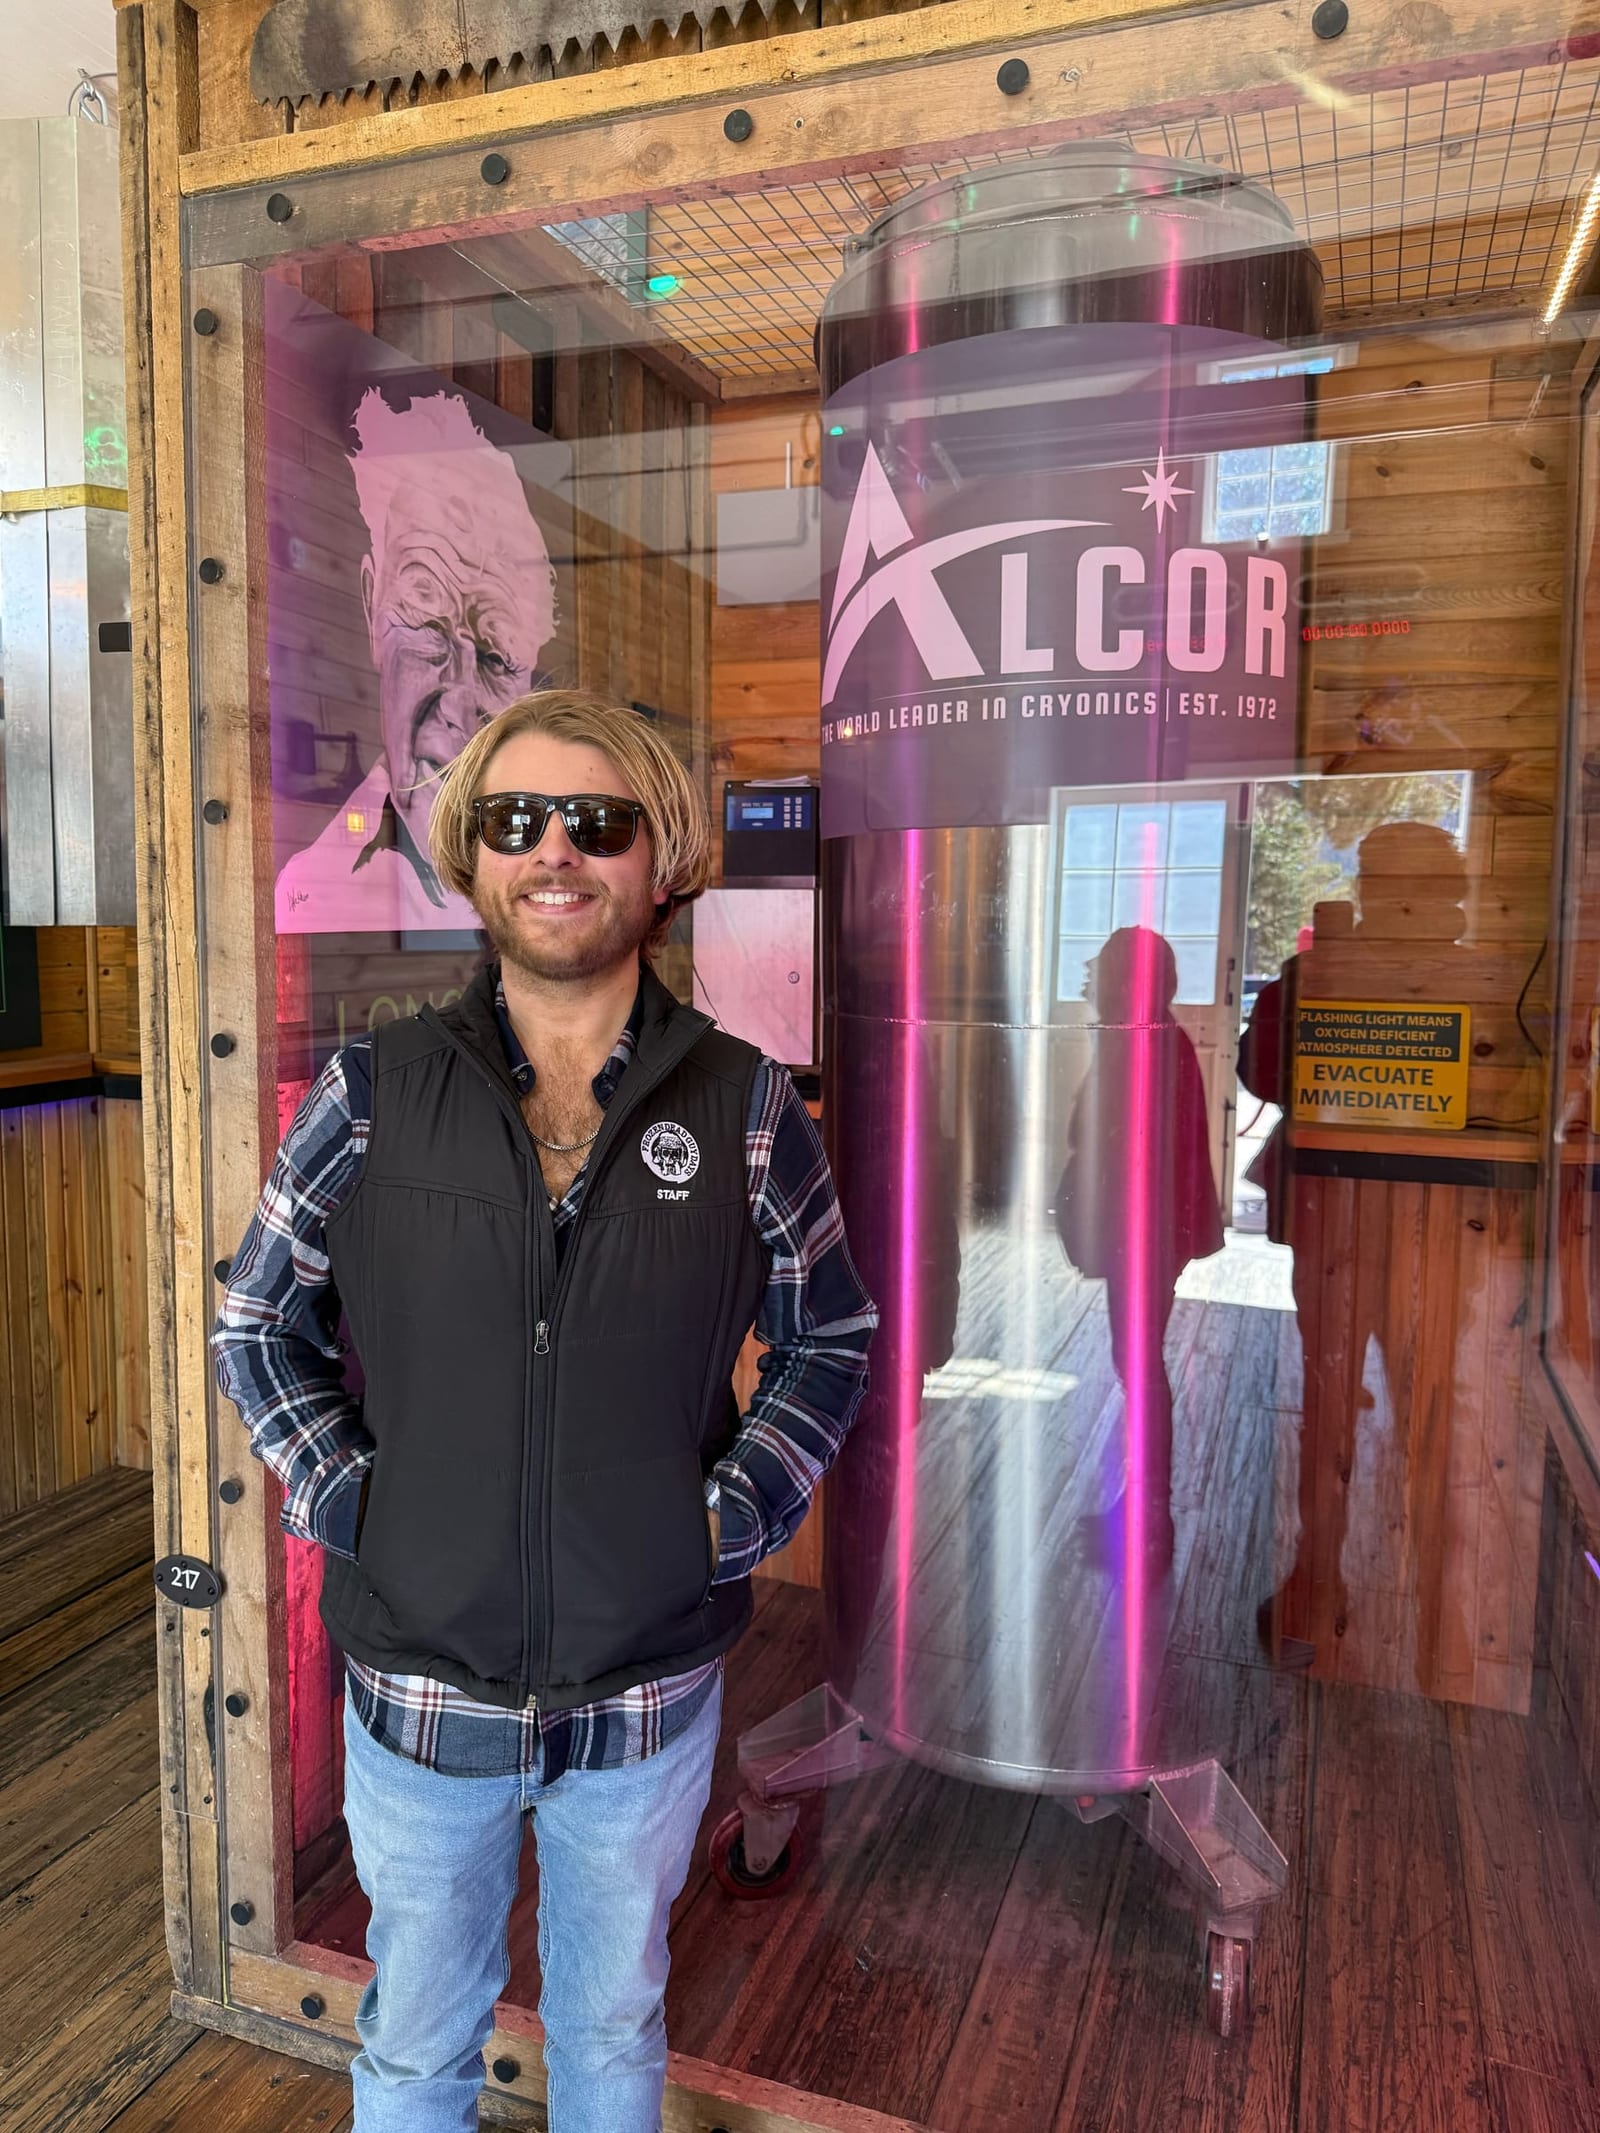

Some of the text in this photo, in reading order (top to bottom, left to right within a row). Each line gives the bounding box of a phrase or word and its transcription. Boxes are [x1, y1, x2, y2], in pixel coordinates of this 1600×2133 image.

[821, 440, 1288, 708] ALCOR
[821, 691, 1277, 746] THE WORLD LEADER IN CRYONICS EST. 1972
[1300, 1011, 1453, 1028] FLASHING LIGHT MEANS
[1314, 1027, 1437, 1042] OXYGEN DEFICIENT
[1299, 1041, 1452, 1058] ATMOSPHERE DETECTED
[1312, 1063, 1434, 1087] EVACUATE
[641, 1123, 664, 1152] FROZEN
[664, 1123, 688, 1138] DEAD
[685, 1137, 698, 1156] GUY
[656, 1188, 690, 1201] STAFF
[171, 1566, 200, 1590] 217
